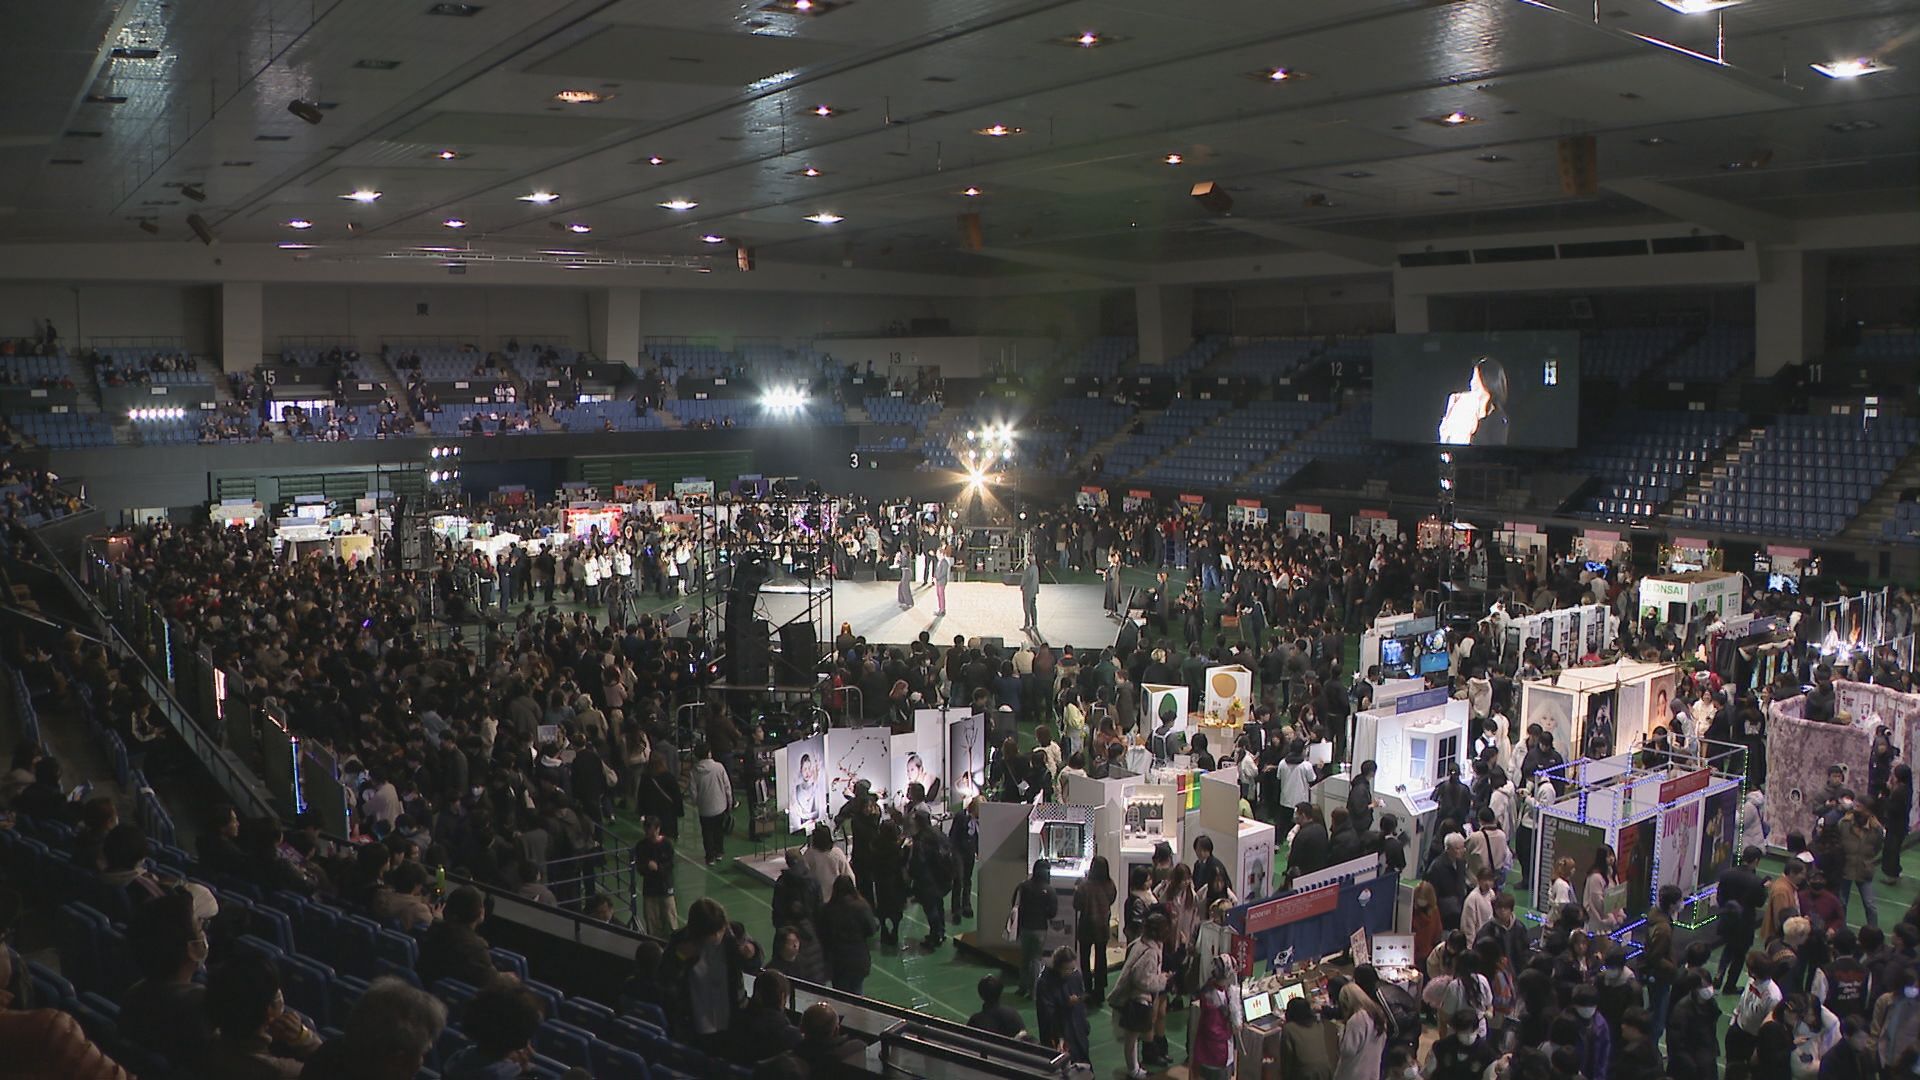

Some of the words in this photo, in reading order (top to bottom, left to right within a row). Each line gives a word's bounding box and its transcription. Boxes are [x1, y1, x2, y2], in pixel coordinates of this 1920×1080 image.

[890, 352, 901, 364] 13
[1330, 361, 1343, 376] 12
[1809, 364, 1821, 383] 11
[262, 370, 277, 385] 15
[850, 453, 859, 467] 3
[1558, 821, 1590, 836] Remix
